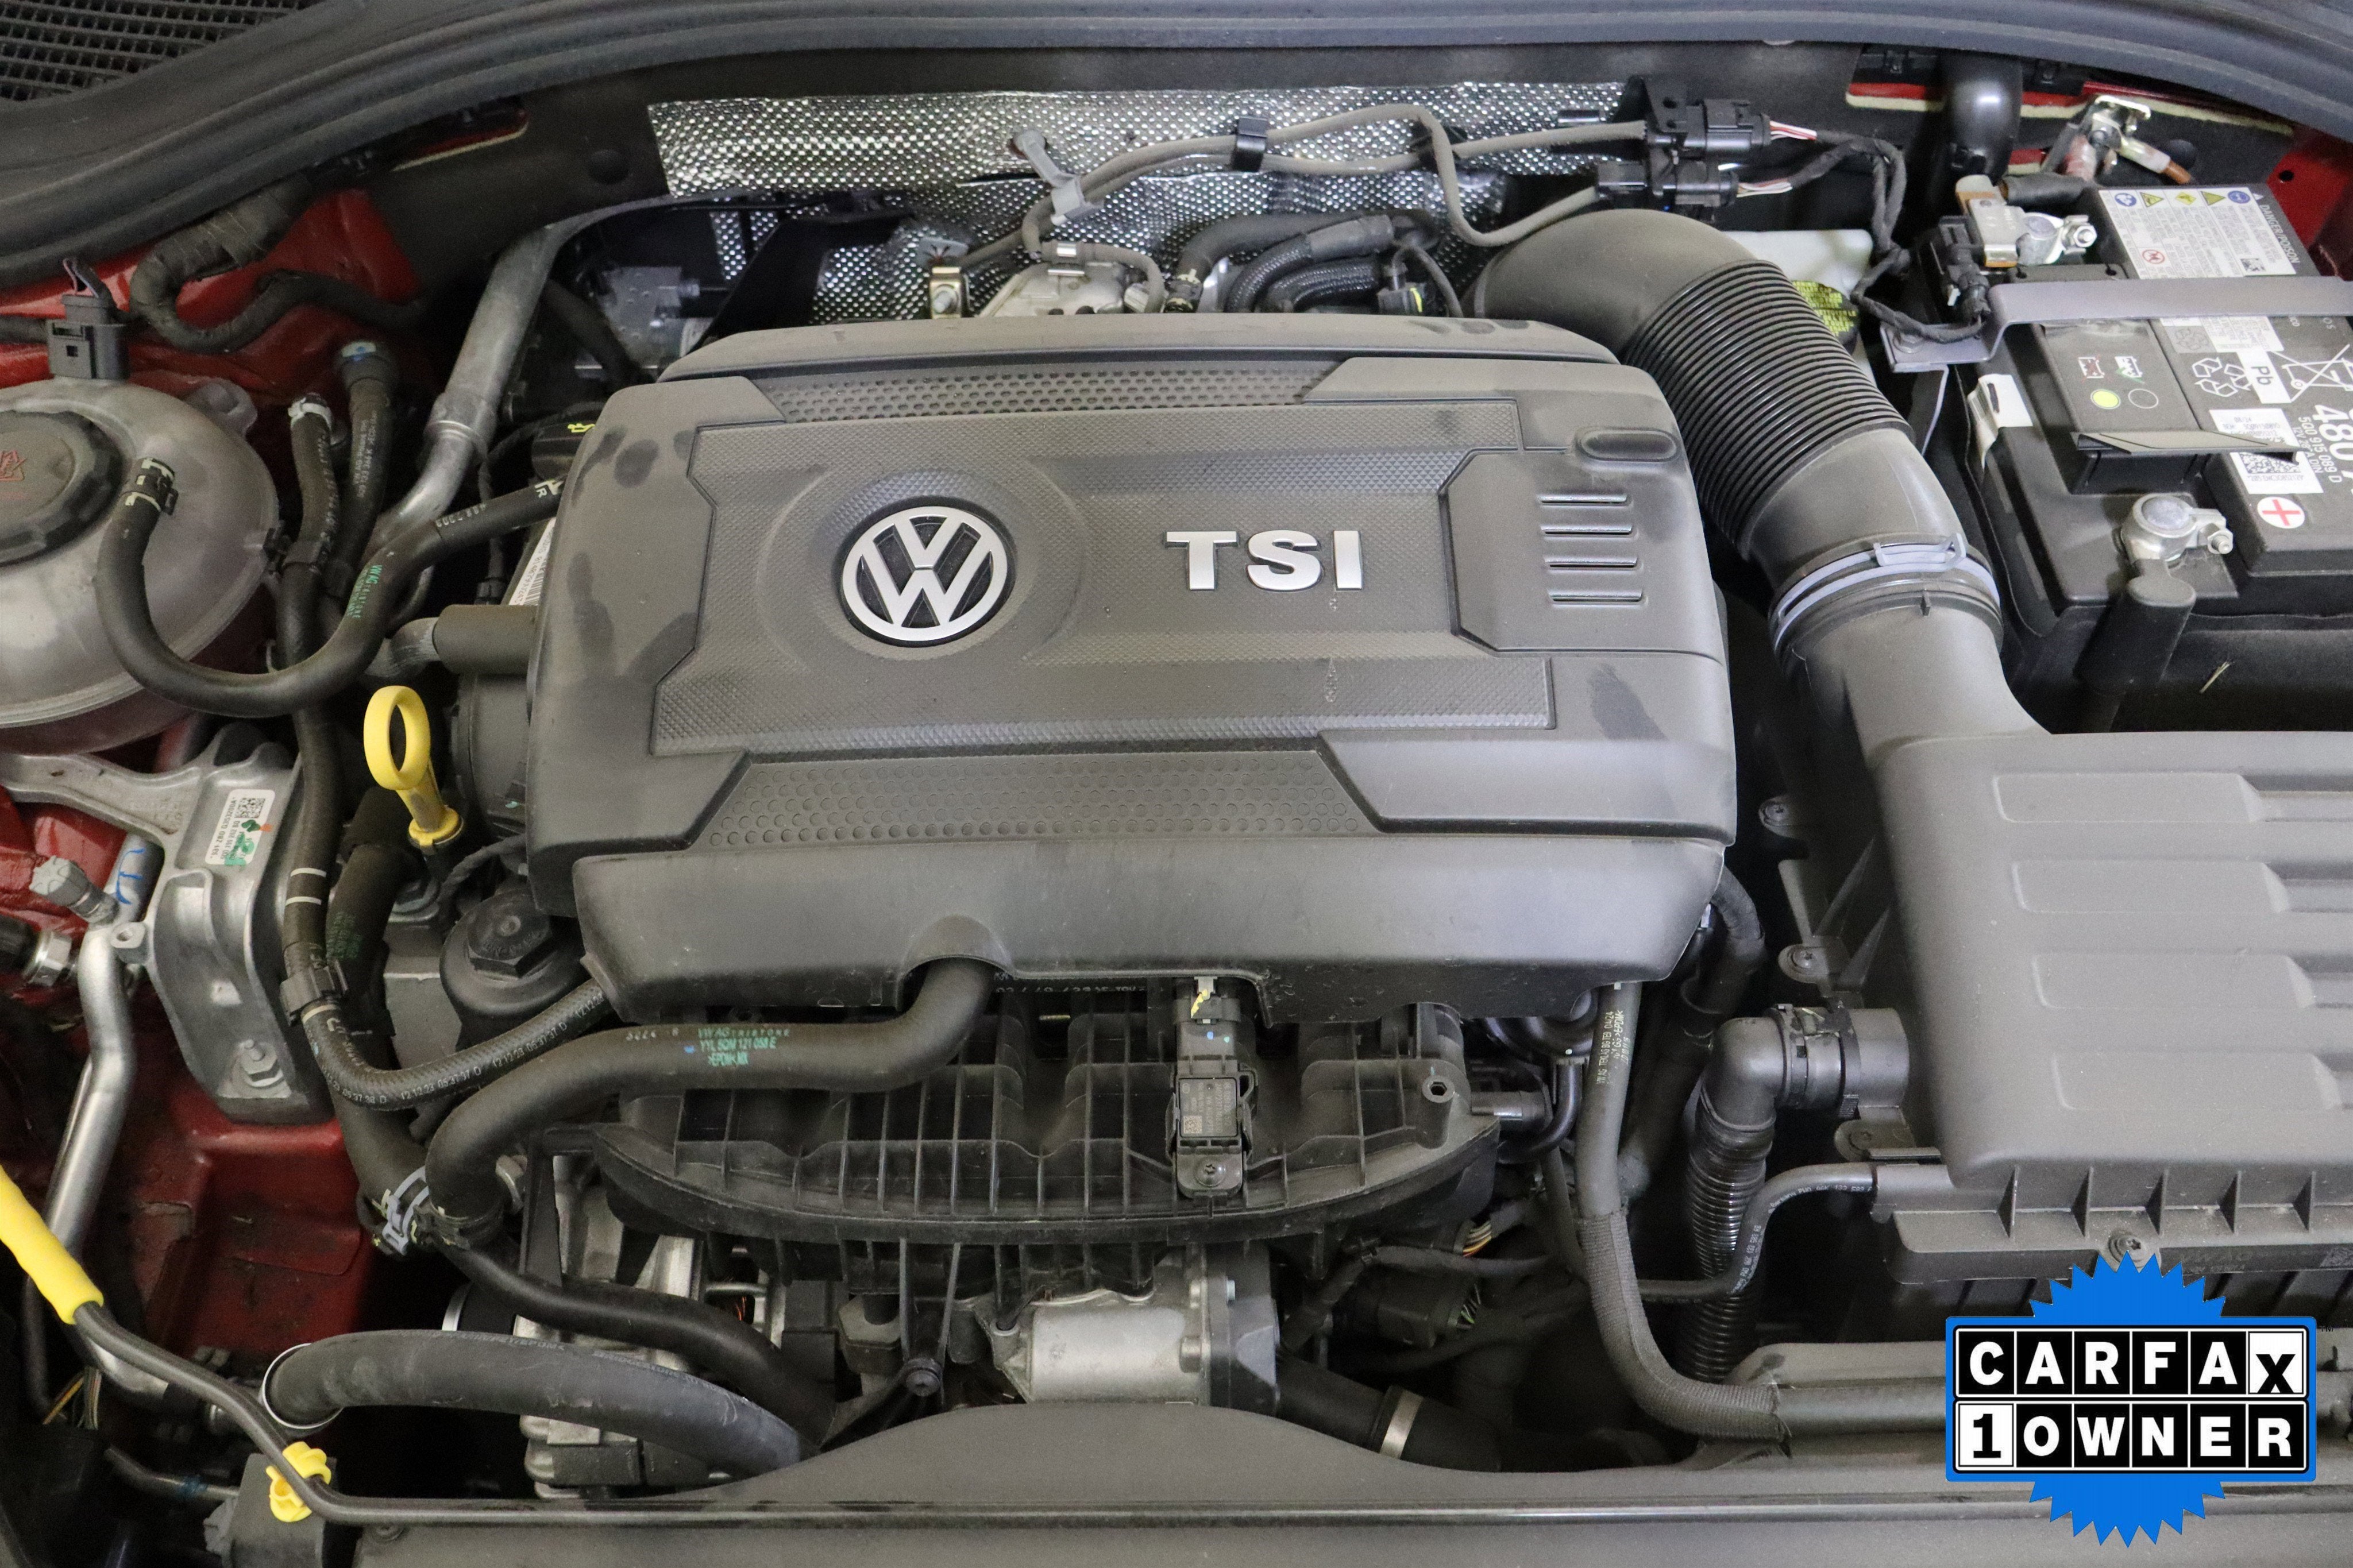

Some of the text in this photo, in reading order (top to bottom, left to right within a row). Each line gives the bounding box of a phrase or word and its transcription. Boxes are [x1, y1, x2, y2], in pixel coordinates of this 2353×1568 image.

[2260, 204, 2300, 264] DANGER/POISON
[2251, 366, 2273, 385] Pb
[2309, 437, 2327, 453] 915
[2319, 455, 2337, 472] 089
[2309, 459, 2324, 473] DIN
[536, 488, 547, 498] R
[1166, 529, 1363, 591] TSI
[1603, 1010, 1614, 1029] 04/24
